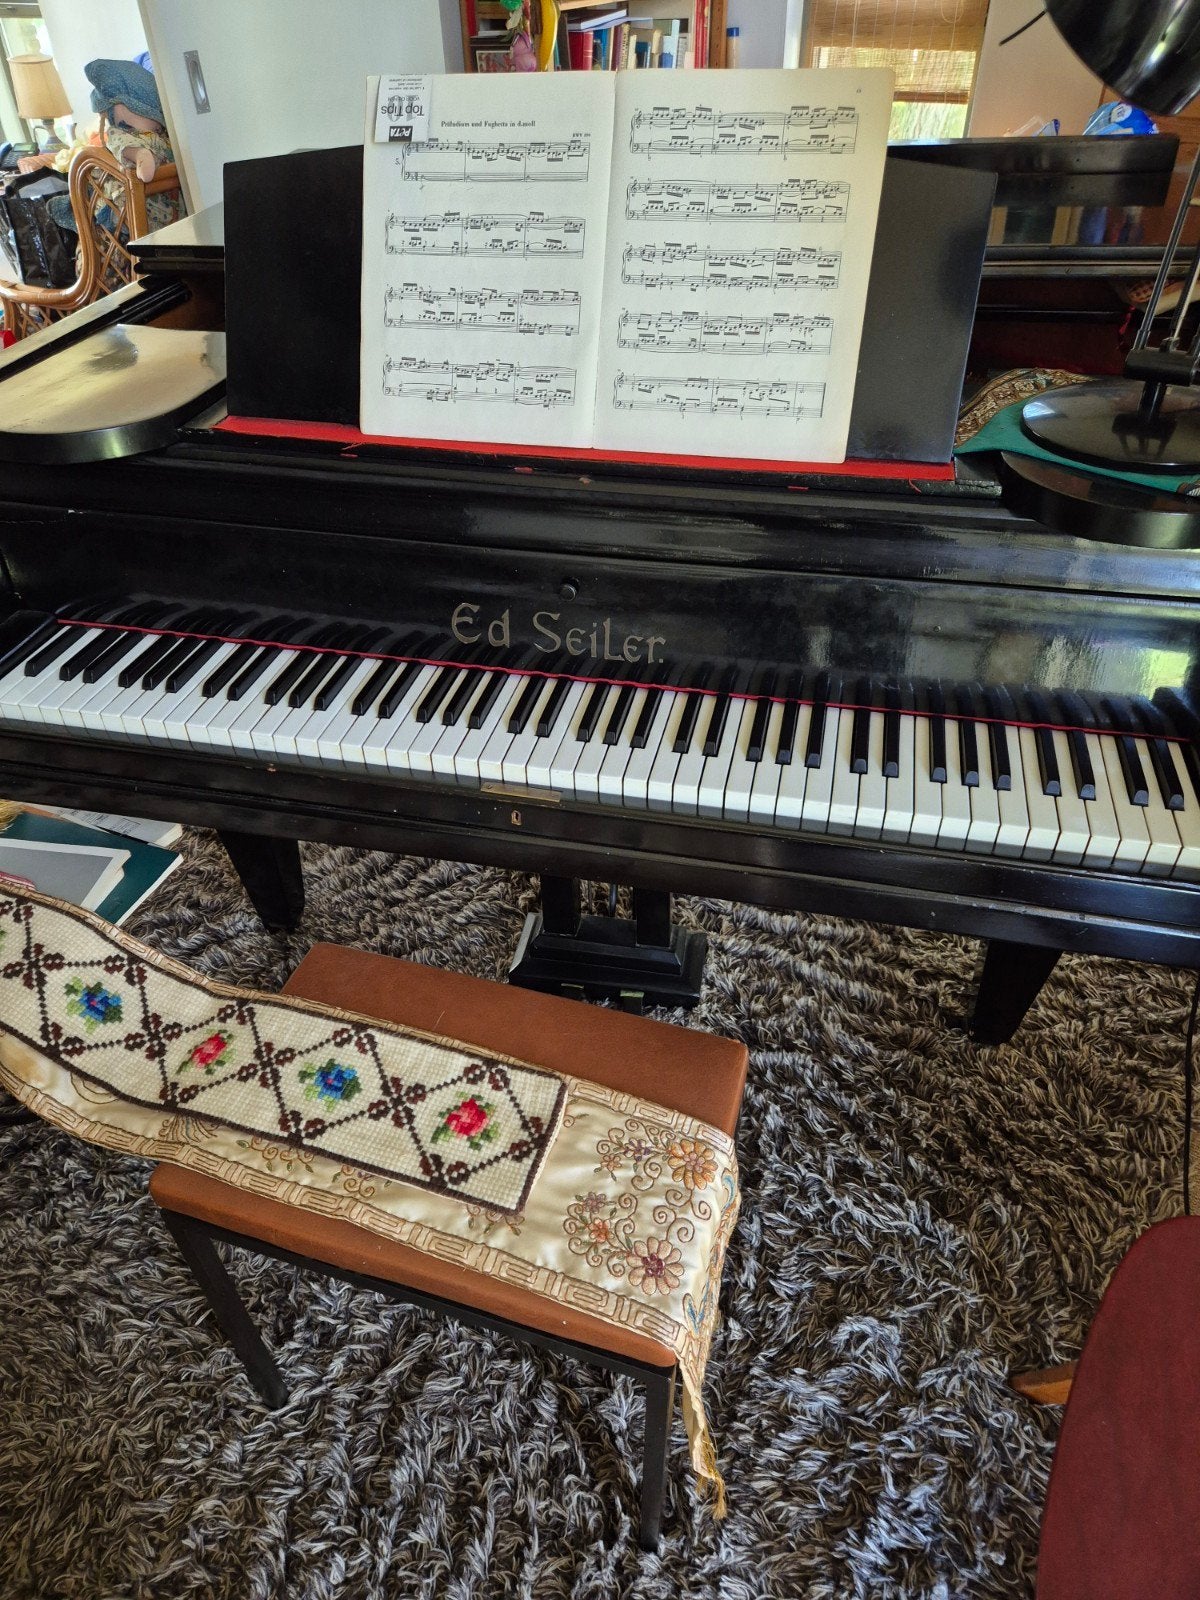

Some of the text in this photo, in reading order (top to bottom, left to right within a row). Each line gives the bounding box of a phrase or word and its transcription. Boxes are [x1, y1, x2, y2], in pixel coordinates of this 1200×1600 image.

[381, 102, 425, 117] Top Tips
[451, 602, 510, 649] Ed
